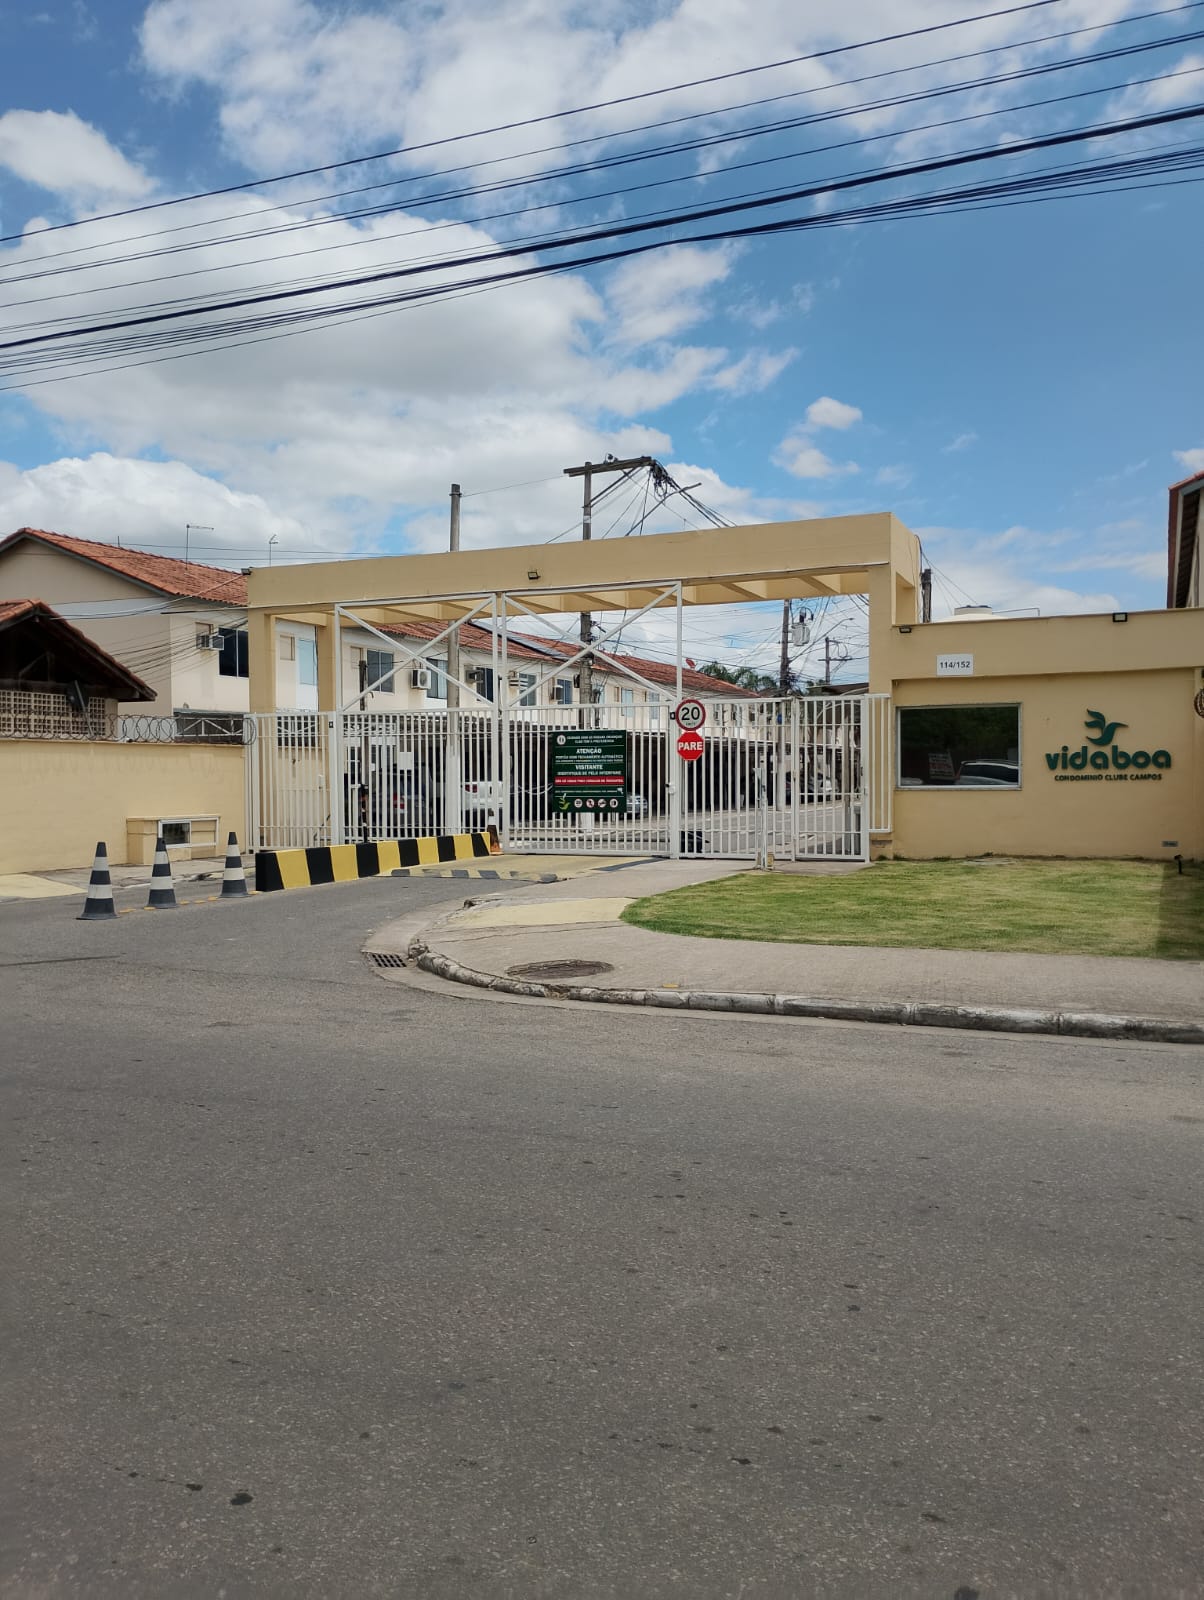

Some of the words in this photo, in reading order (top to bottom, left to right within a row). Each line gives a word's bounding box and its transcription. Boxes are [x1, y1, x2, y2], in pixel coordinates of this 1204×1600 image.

[940, 660, 971, 669] 114/152
[681, 706, 700, 720] 20
[576, 746, 602, 754] ATENÇÃO
[678, 741, 703, 751] PARE
[1130, 773, 1162, 781] CAMPOS
